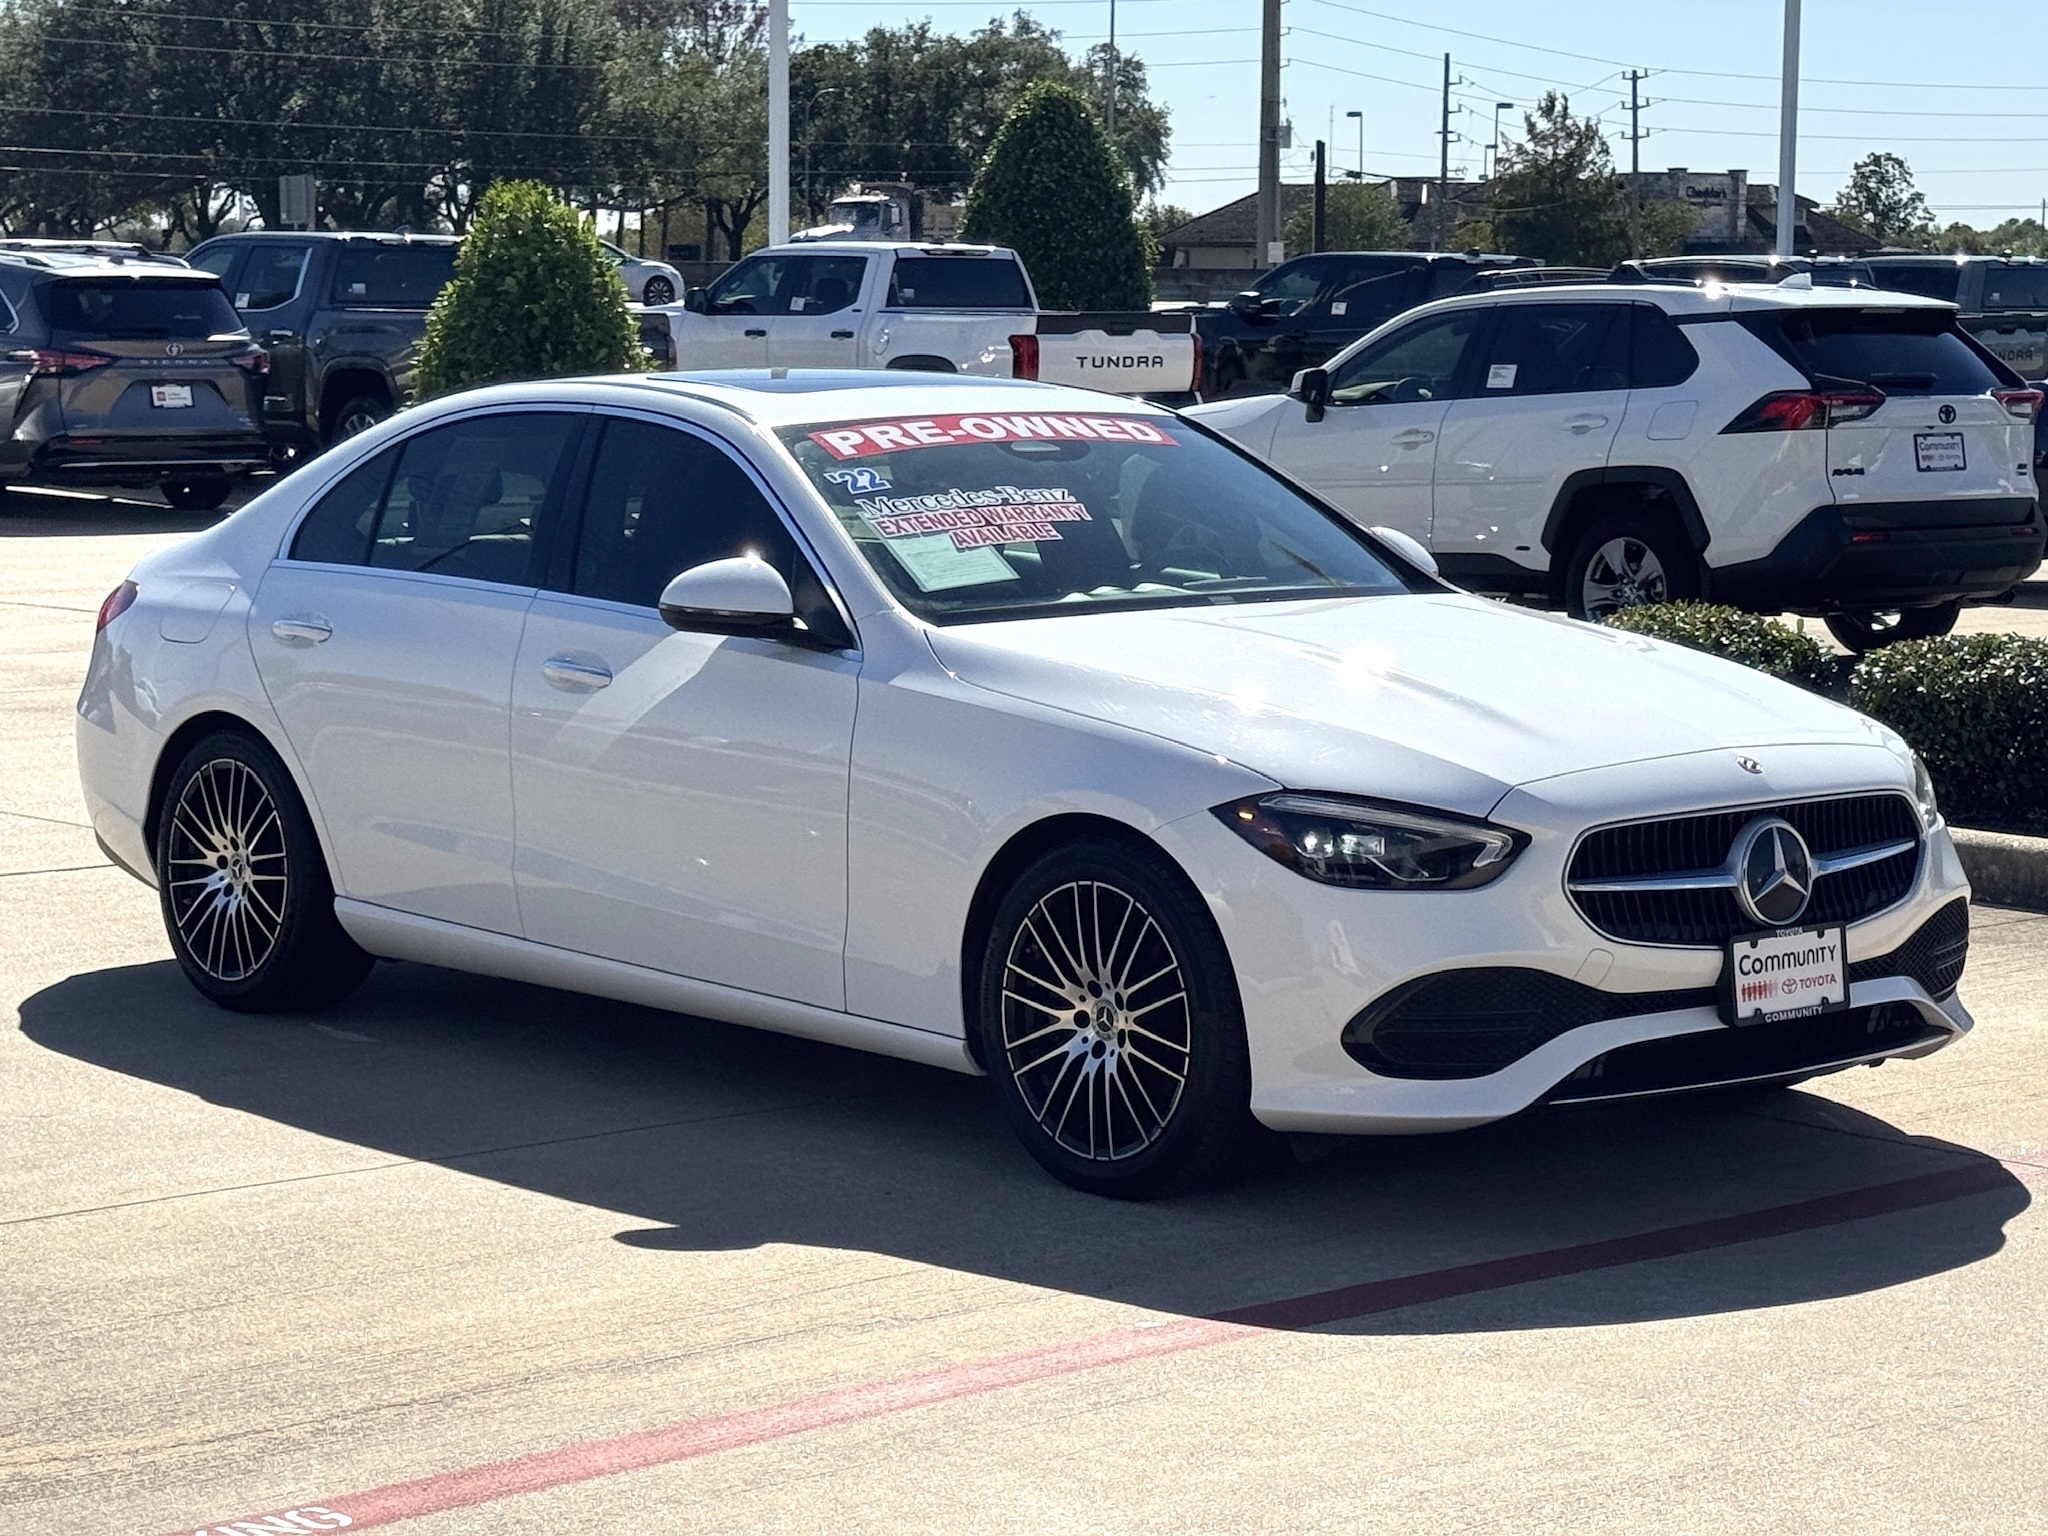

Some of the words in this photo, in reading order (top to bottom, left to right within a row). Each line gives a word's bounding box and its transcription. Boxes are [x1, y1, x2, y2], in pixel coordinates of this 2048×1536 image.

[1076, 355, 1164, 369] TUNDRA
[820, 416, 1164, 456] PRE-OWNED
[825, 467, 891, 493] '22
[857, 487, 1075, 518] Mercedes-Benz
[877, 509, 981, 536] EXTENDED
[981, 503, 1091, 527] WARRANTY
[951, 523, 1060, 547] AVAILABLE
[1775, 926, 1804, 938] TOYOTA
[1799, 973, 1837, 989] TOYOTA
[1764, 1005, 1824, 1023] COMMUNITY
